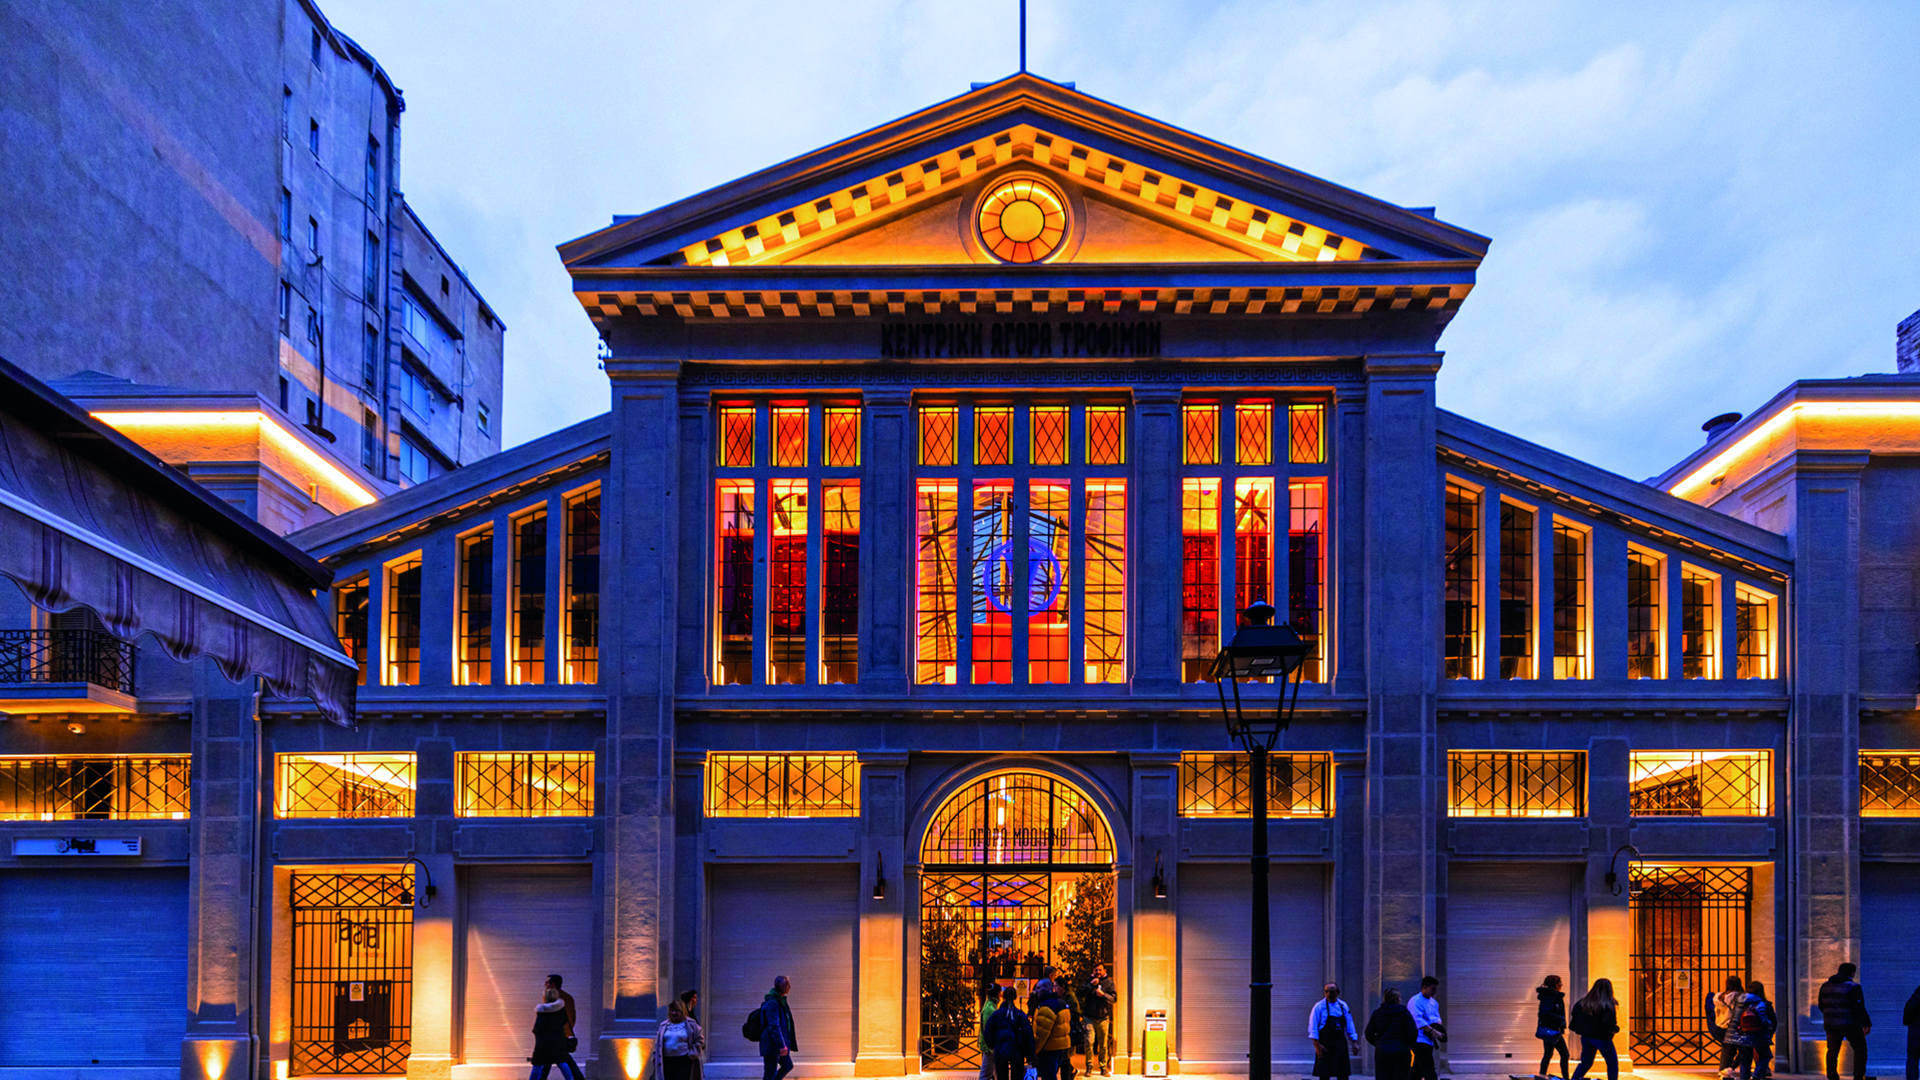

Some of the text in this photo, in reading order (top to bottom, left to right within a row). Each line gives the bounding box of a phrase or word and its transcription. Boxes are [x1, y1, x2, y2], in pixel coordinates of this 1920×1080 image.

[881, 321, 1161, 355] ΚΕΝΤΡΙΚΗ ΑΓΟΡΑ ΤΡΟΦΙΜΩΝ
[969, 827, 1007, 847] ΑΓΟΡΑ
